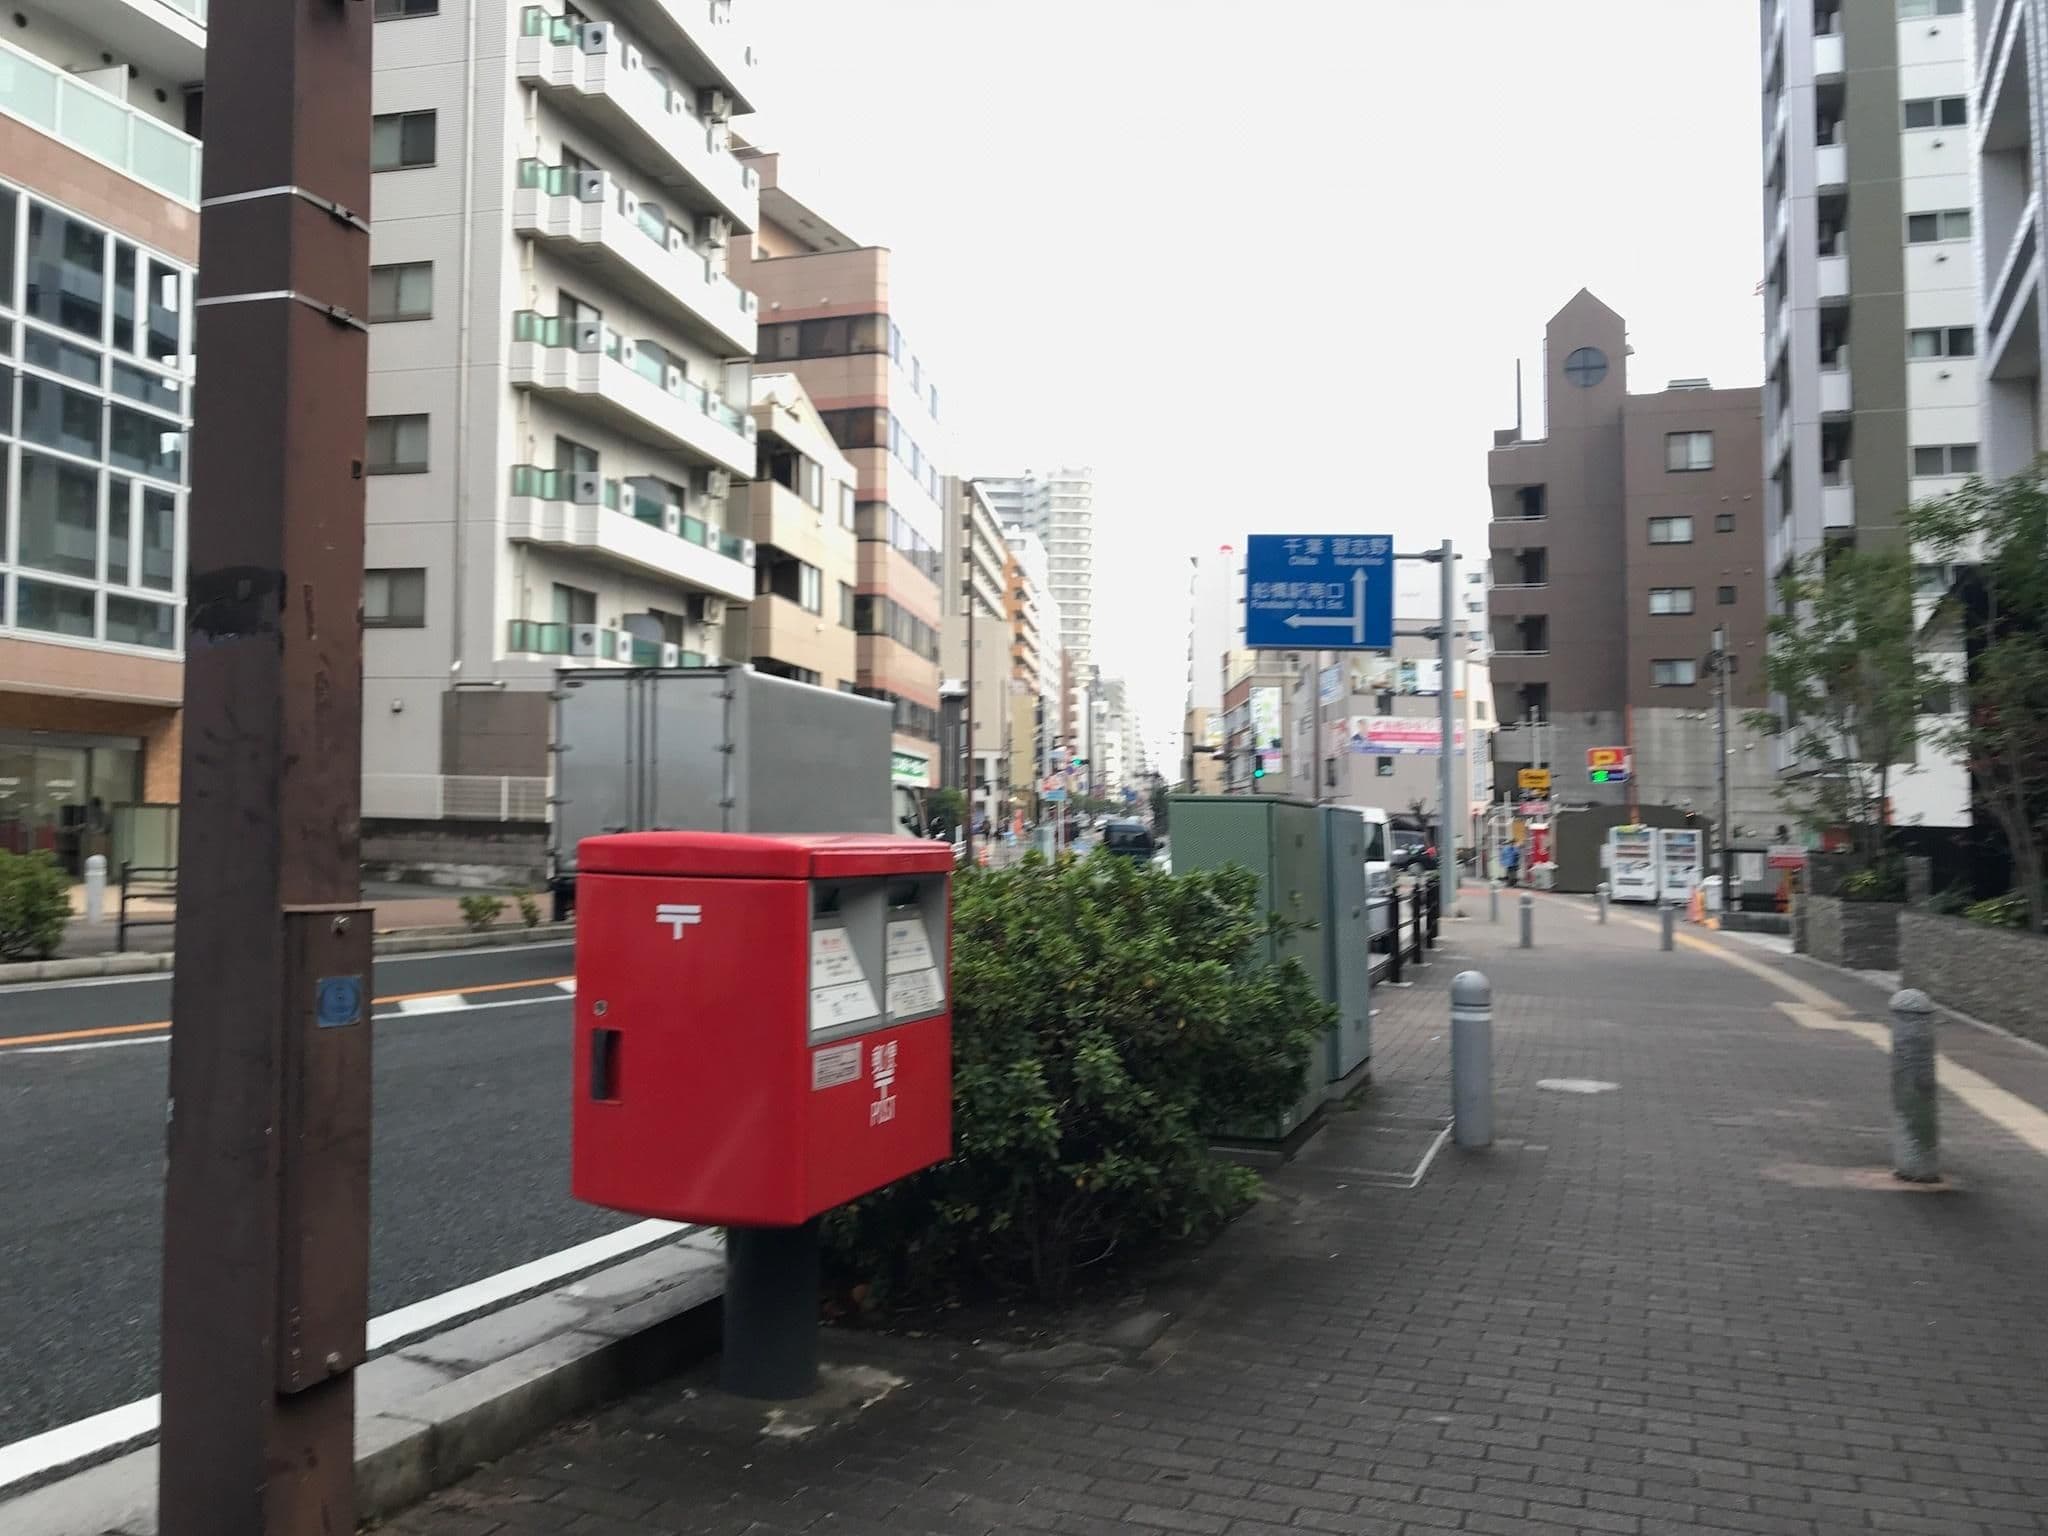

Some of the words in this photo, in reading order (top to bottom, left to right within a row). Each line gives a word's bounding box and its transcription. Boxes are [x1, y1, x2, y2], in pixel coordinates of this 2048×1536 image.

[1283, 538, 1324, 555] 千葉
[1331, 538, 1389, 555] 習志野
